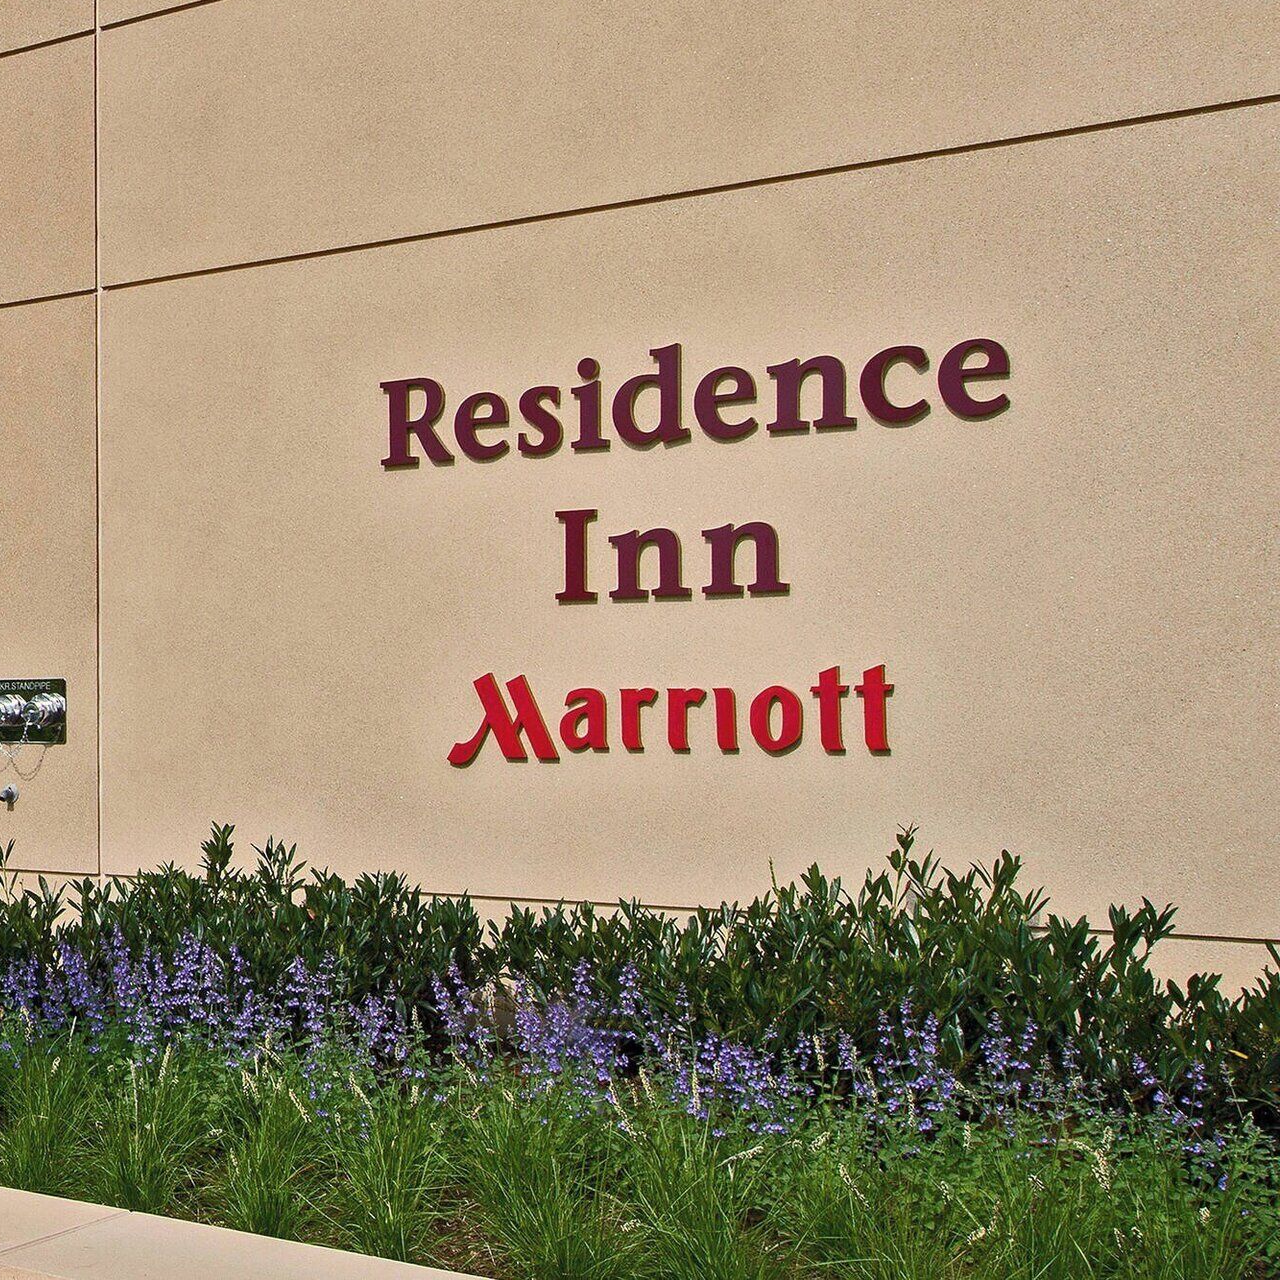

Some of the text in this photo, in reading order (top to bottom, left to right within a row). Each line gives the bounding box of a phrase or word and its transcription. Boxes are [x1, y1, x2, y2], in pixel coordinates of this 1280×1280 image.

[379, 336, 1012, 471] Residence
[554, 508, 792, 606] Inn
[445, 664, 895, 768] Marriott
